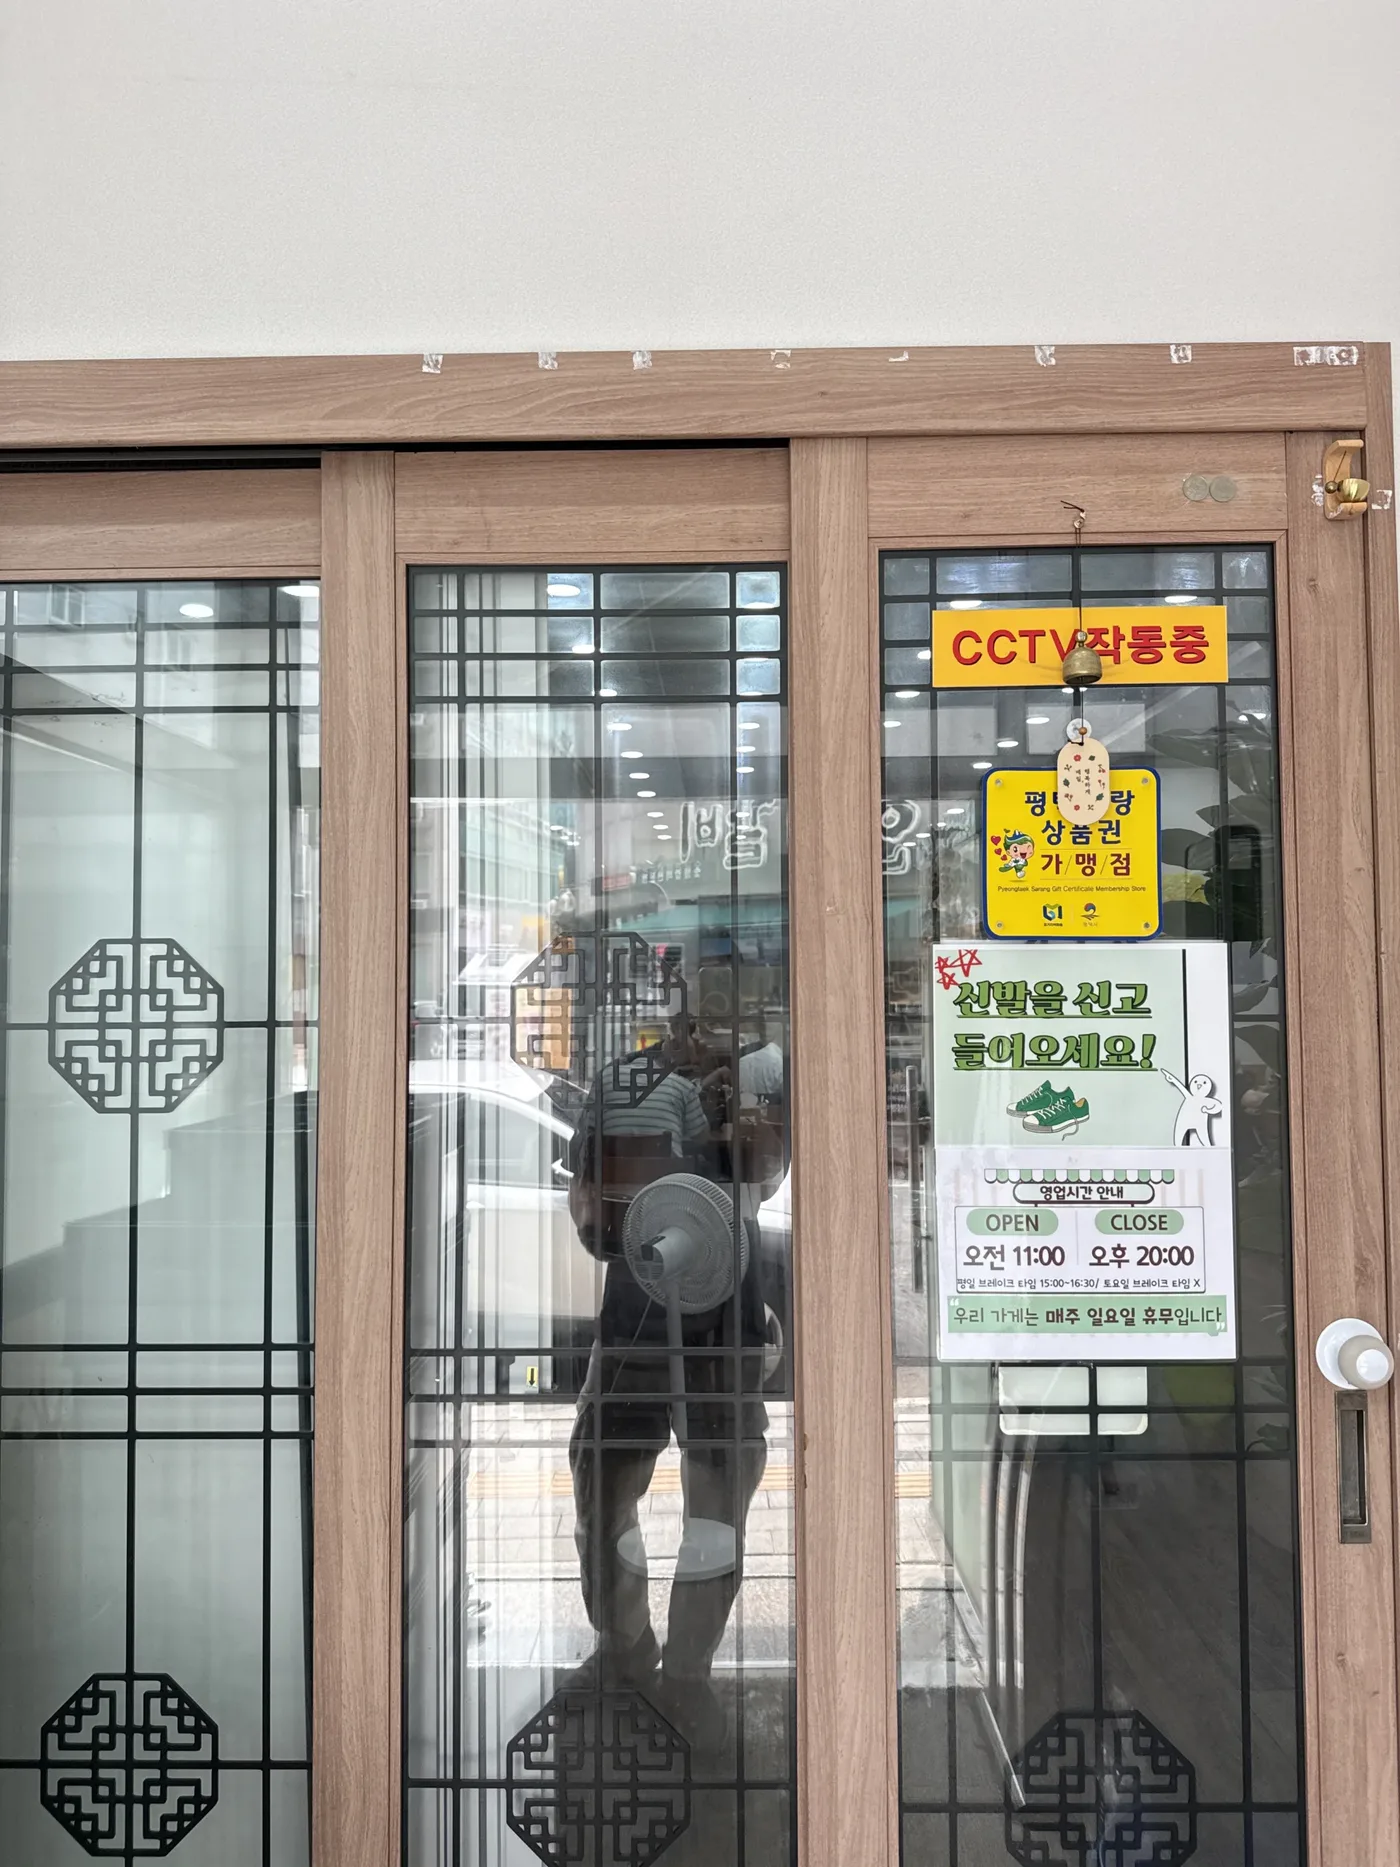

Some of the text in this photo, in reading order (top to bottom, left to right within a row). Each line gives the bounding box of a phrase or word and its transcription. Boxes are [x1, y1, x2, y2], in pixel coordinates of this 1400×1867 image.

[1024, 790, 1135, 817] 평랑
[1041, 819, 1122, 846] 상품권
[997, 885, 1029, 893] Pyeongtaek
[1031, 885, 1051, 893] Sarang
[1095, 885, 1130, 893] Membership
[953, 979, 1151, 1019] 신발을 신고
[952, 1032, 1157, 1070] 들어오세요!
[1039, 1185, 1124, 1201] 영업시간 안내
[985, 1214, 1040, 1232] OPEN
[1110, 1213, 1168, 1231] CLOSE
[963, 1243, 1065, 1271] 오전 11:00
[1089, 1243, 1195, 1269] 오후 20:00
[957, 1278, 976, 1289] 평일
[978, 1278, 1014, 1288] 브레이크
[1018, 1278, 1037, 1289] 타임
[1103, 1278, 1130, 1289] 토요일
[1132, 1278, 1169, 1288] 브레이크
[1171, 1278, 1191, 1289] 타임
[1193, 1278, 1201, 1288] X
[990, 1307, 1039, 1327] 가게는
[1045, 1308, 1080, 1325] 매주
[1087, 1307, 1136, 1327] 일요일
